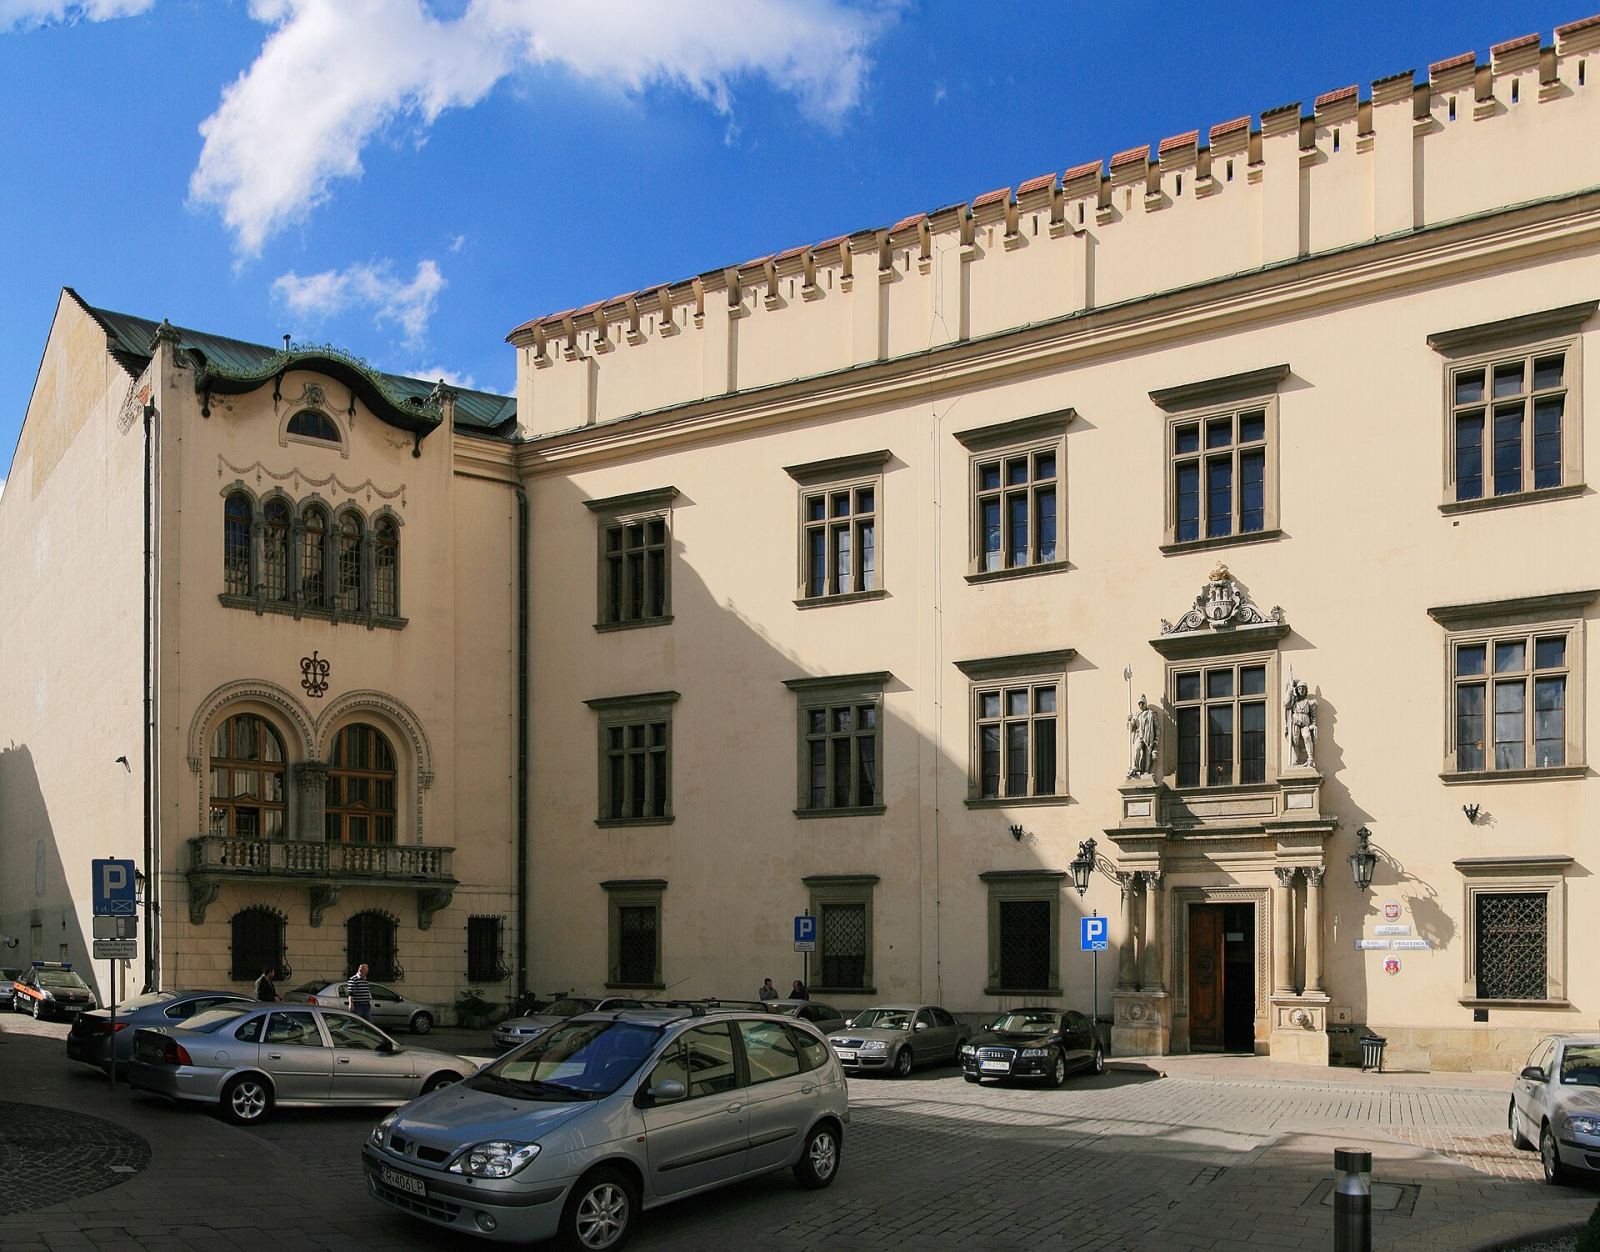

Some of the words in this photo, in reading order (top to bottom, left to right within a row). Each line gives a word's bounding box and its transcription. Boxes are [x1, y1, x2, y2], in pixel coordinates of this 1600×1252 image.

[103, 864, 126, 898] P
[800, 919, 812, 937] P
[1087, 920, 1102, 941] P
